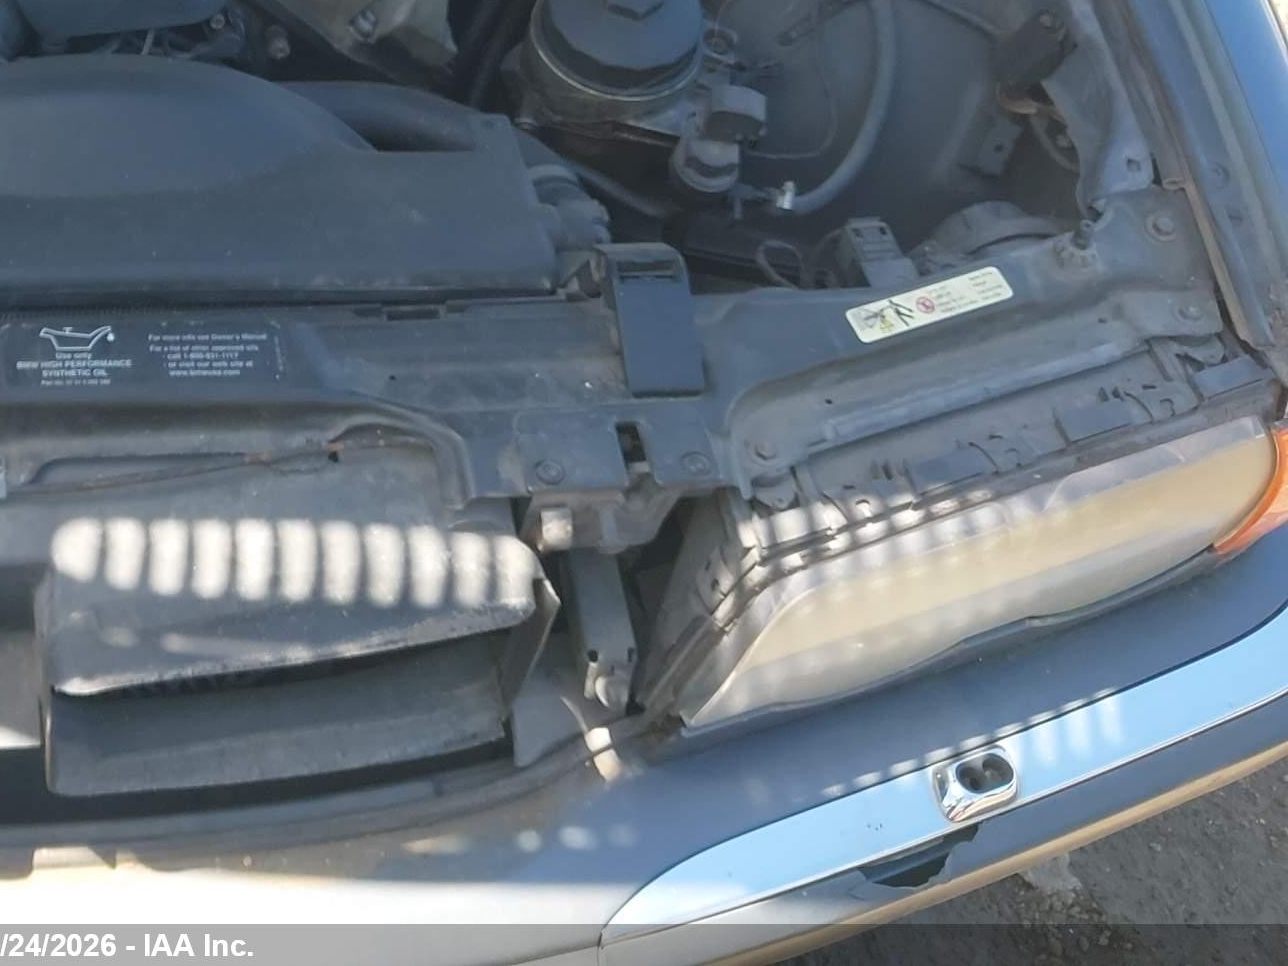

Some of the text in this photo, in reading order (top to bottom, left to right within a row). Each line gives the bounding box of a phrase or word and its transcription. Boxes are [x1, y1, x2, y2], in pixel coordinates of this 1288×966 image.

[40, 360, 63, 369] HIGH
[64, 359, 132, 369] PERFORMANCE
[42, 368, 108, 377] SYNTHETIC OIL
